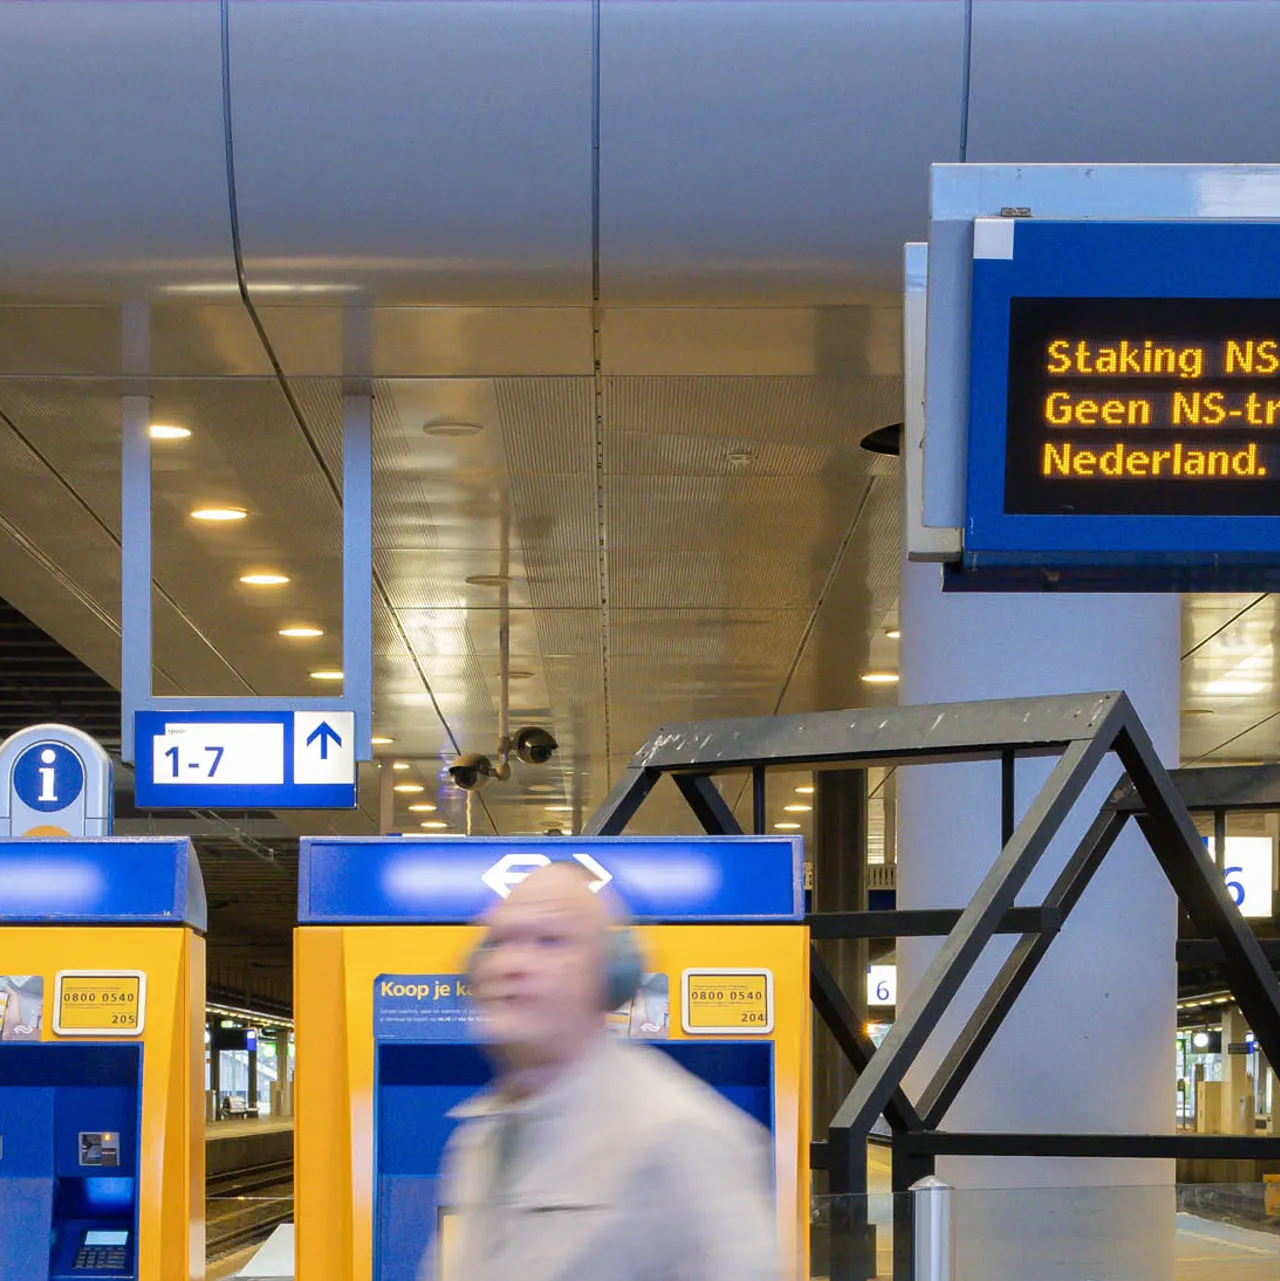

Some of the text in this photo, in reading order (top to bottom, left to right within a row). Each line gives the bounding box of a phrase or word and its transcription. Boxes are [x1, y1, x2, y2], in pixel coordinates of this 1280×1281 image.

[1047, 340, 1280, 378] Staking NS
[1045, 391, 1151, 425] Geen
[1042, 442, 1267, 476] Nederland.
[164, 745, 225, 778] 1-7
[37, 748, 58, 802] i
[63, 992, 135, 1002] 0800 0540
[380, 980, 430, 1001] Koop
[433, 980, 451, 1001] je
[691, 991, 762, 1000] 0800 0540
[876, 980, 890, 1001] 6
[111, 1014, 135, 1024] 205
[741, 1012, 765, 1022] 204
